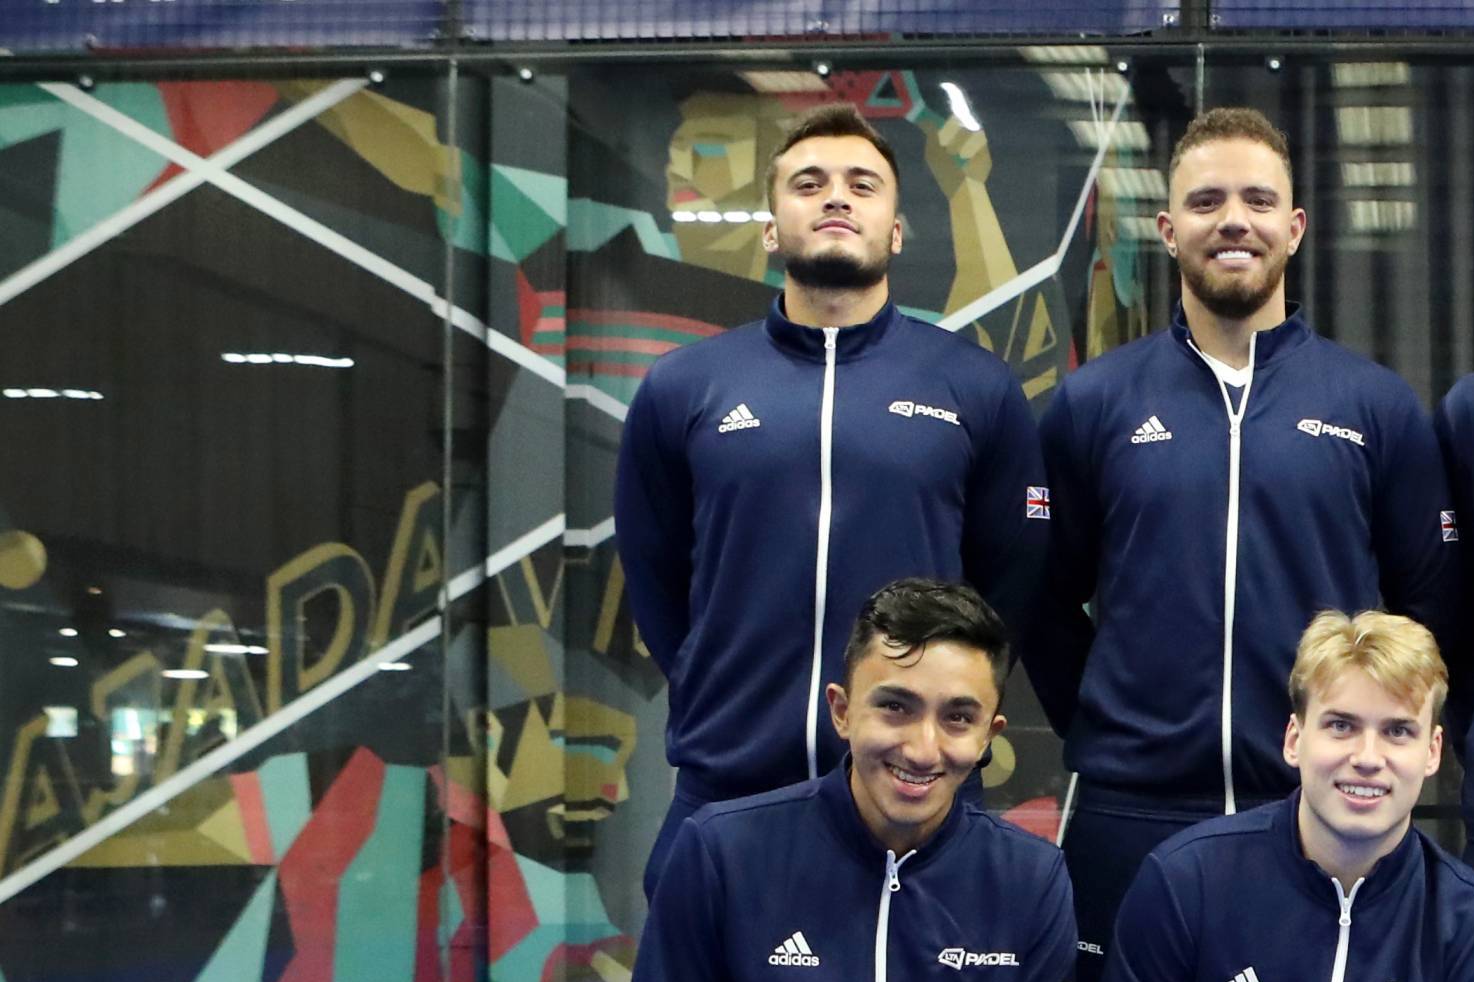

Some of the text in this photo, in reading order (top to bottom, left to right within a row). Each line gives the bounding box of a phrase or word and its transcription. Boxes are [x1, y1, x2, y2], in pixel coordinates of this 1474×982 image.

[915, 404, 960, 425] PADEL
[718, 417, 761, 433] adidas
[1131, 431, 1172, 444] adidas
[1321, 423, 1365, 446] PADEL
[1077, 941, 1104, 955] DEL
[768, 952, 820, 967] adidas
[965, 952, 1020, 966] PADEL
